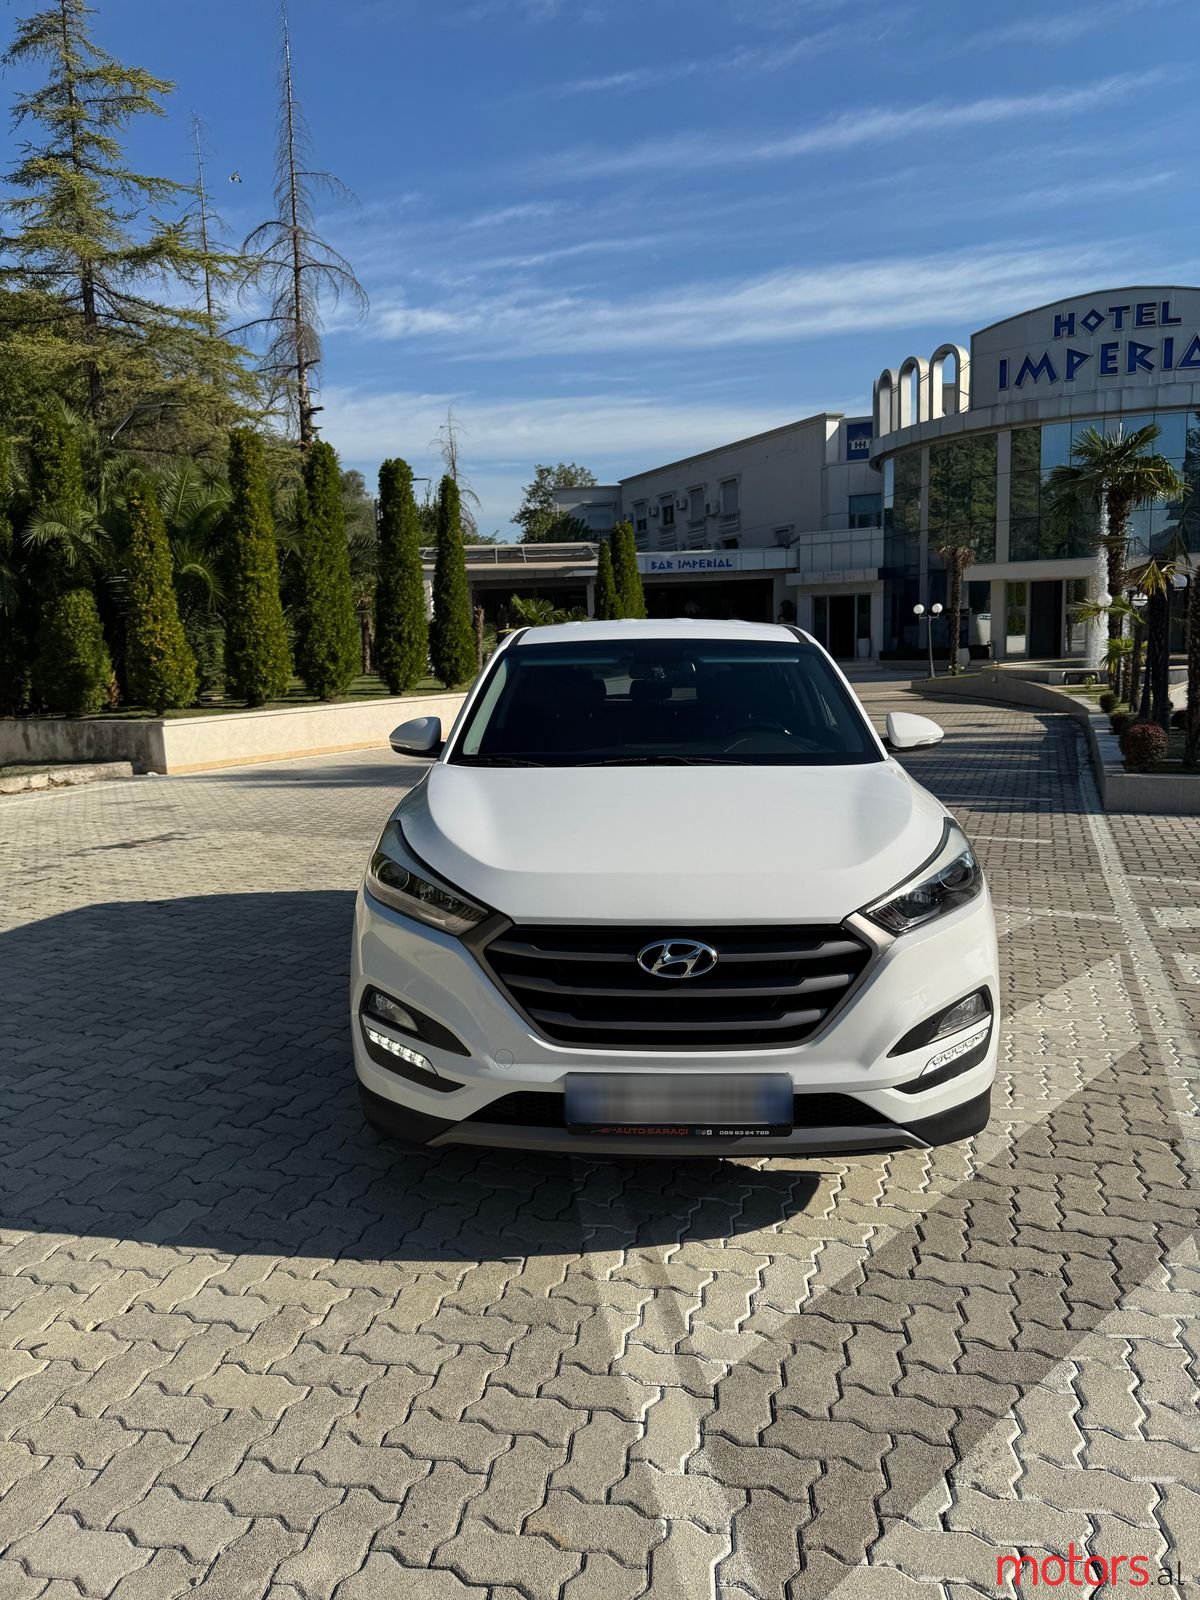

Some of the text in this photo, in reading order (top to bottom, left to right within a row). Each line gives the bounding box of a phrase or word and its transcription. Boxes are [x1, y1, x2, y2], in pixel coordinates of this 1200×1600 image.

[1053, 300, 1182, 338] HOTEL
[651, 558, 732, 570] BAR IMPERIAL
[615, 1127, 646, 1135] AUTO
